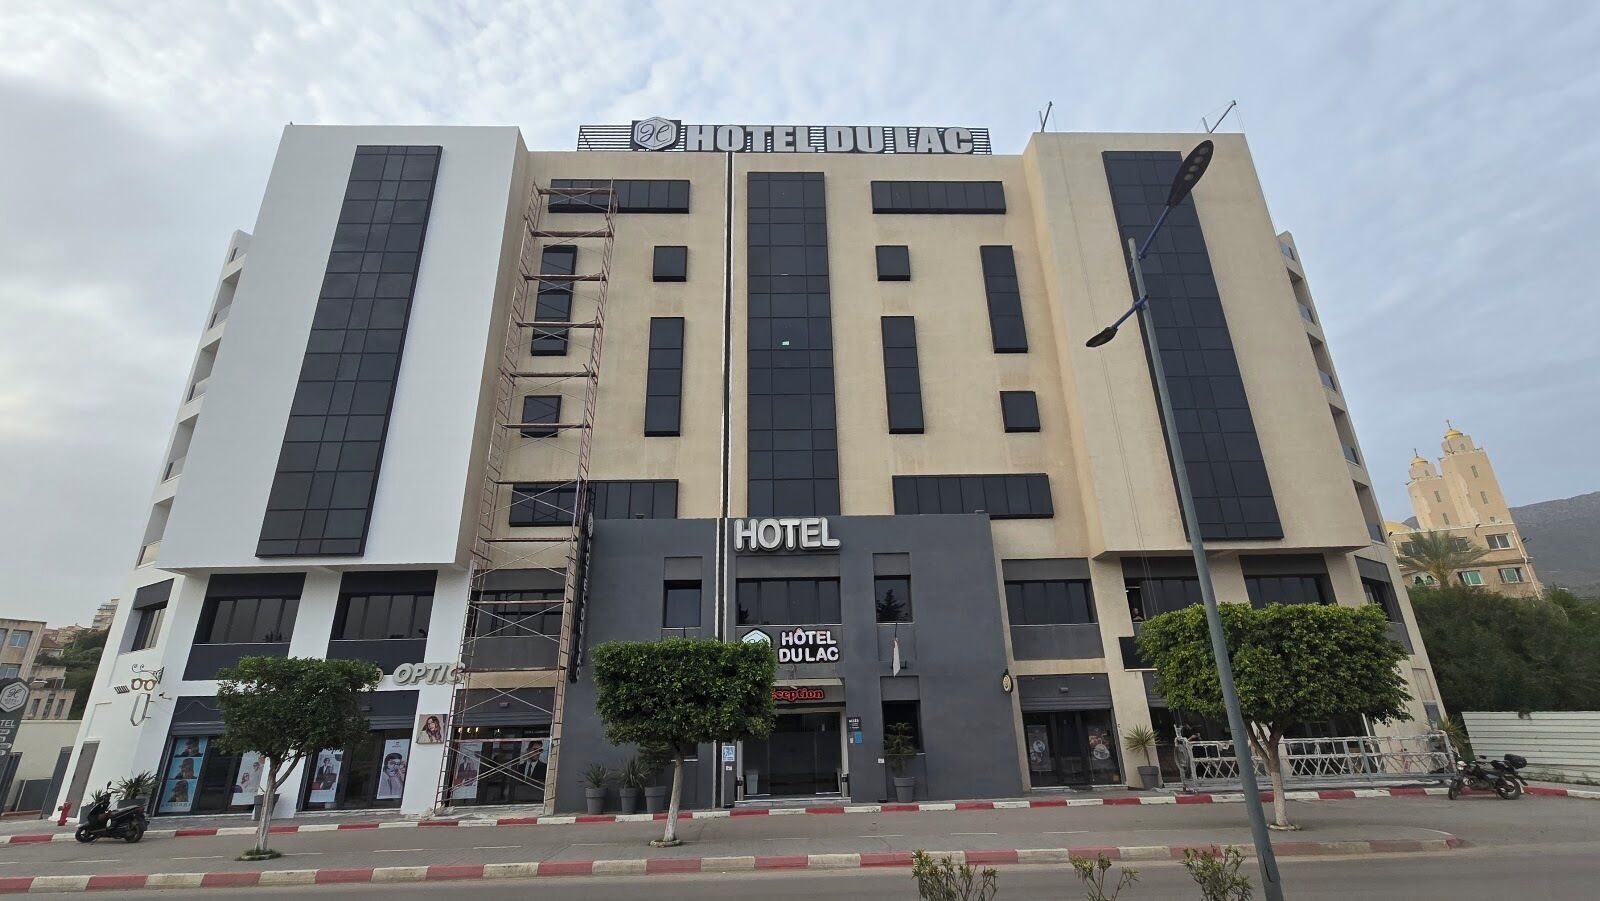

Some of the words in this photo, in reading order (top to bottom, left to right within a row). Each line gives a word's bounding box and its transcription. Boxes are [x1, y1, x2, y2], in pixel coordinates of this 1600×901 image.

[685, 125, 816, 153] HOTEL
[825, 126, 884, 154] DU
[894, 127, 974, 154] LAC
[735, 517, 841, 550] HOTEL
[781, 627, 837, 646] HÔTEL
[778, 648, 803, 663] DU
[804, 646, 839, 662] LAC
[771, 688, 825, 702] ception
